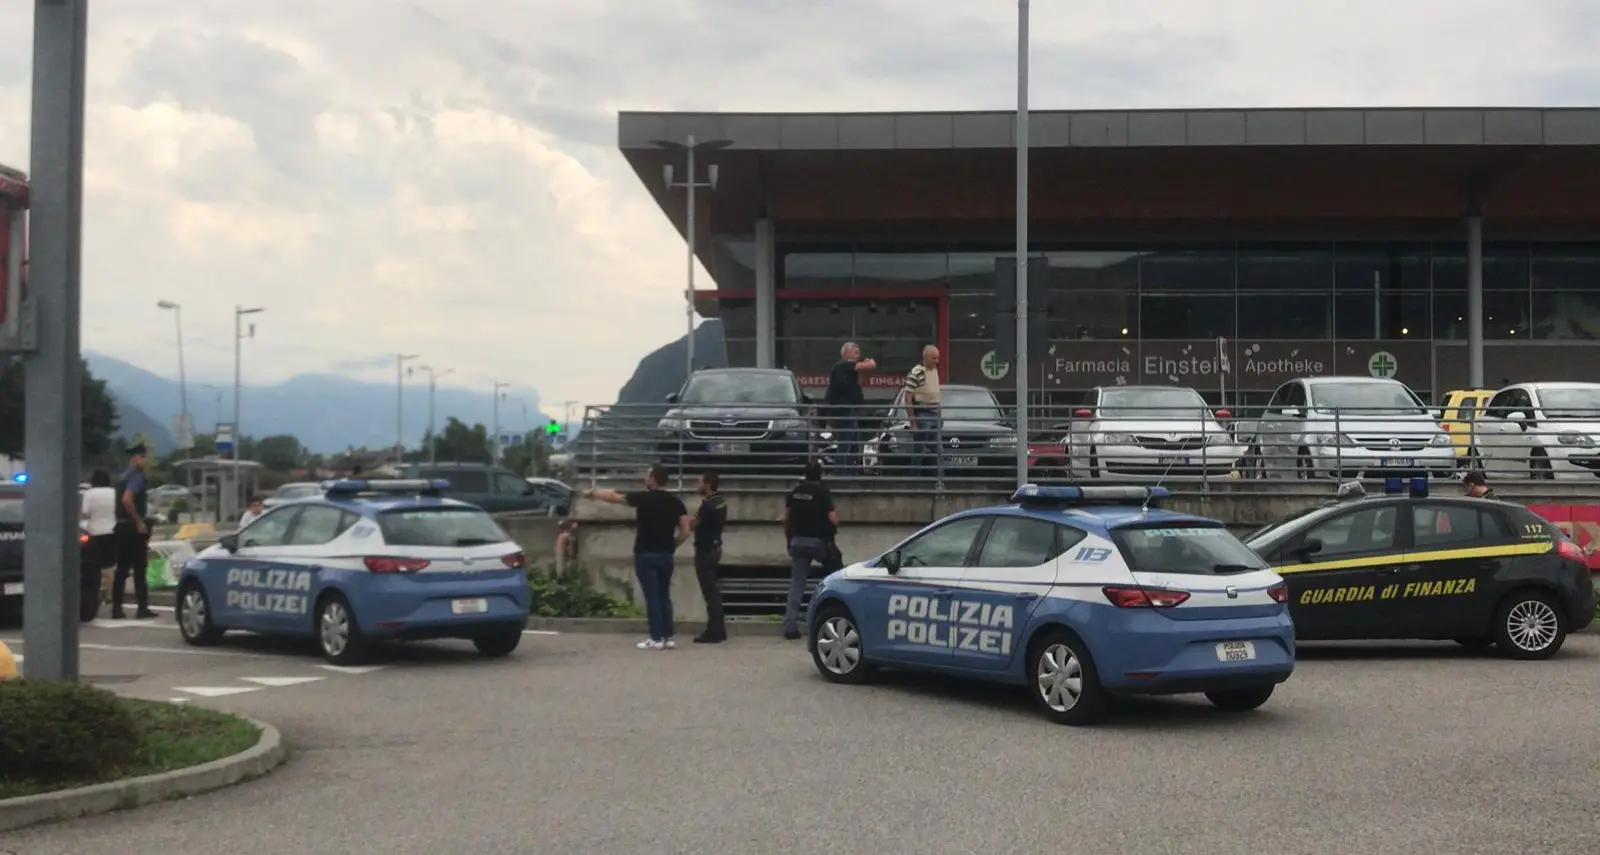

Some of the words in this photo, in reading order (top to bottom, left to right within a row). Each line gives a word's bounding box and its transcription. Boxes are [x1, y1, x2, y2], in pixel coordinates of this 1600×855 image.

[1055, 358, 1130, 373] Farmacia
[1245, 358, 1323, 375] Apotheke
[870, 376, 908, 386] EINGAN
[1524, 524, 1543, 534] 117
[1074, 546, 1113, 562] 113
[227, 568, 311, 591] POLIZIA
[1300, 586, 1375, 605] GUARDIA
[1381, 584, 1397, 599] di
[1403, 577, 1477, 598] FINANZA
[227, 590, 307, 614] POLIZEI
[887, 594, 1013, 629] POLIZIA
[887, 619, 1012, 655] POLIZEI
